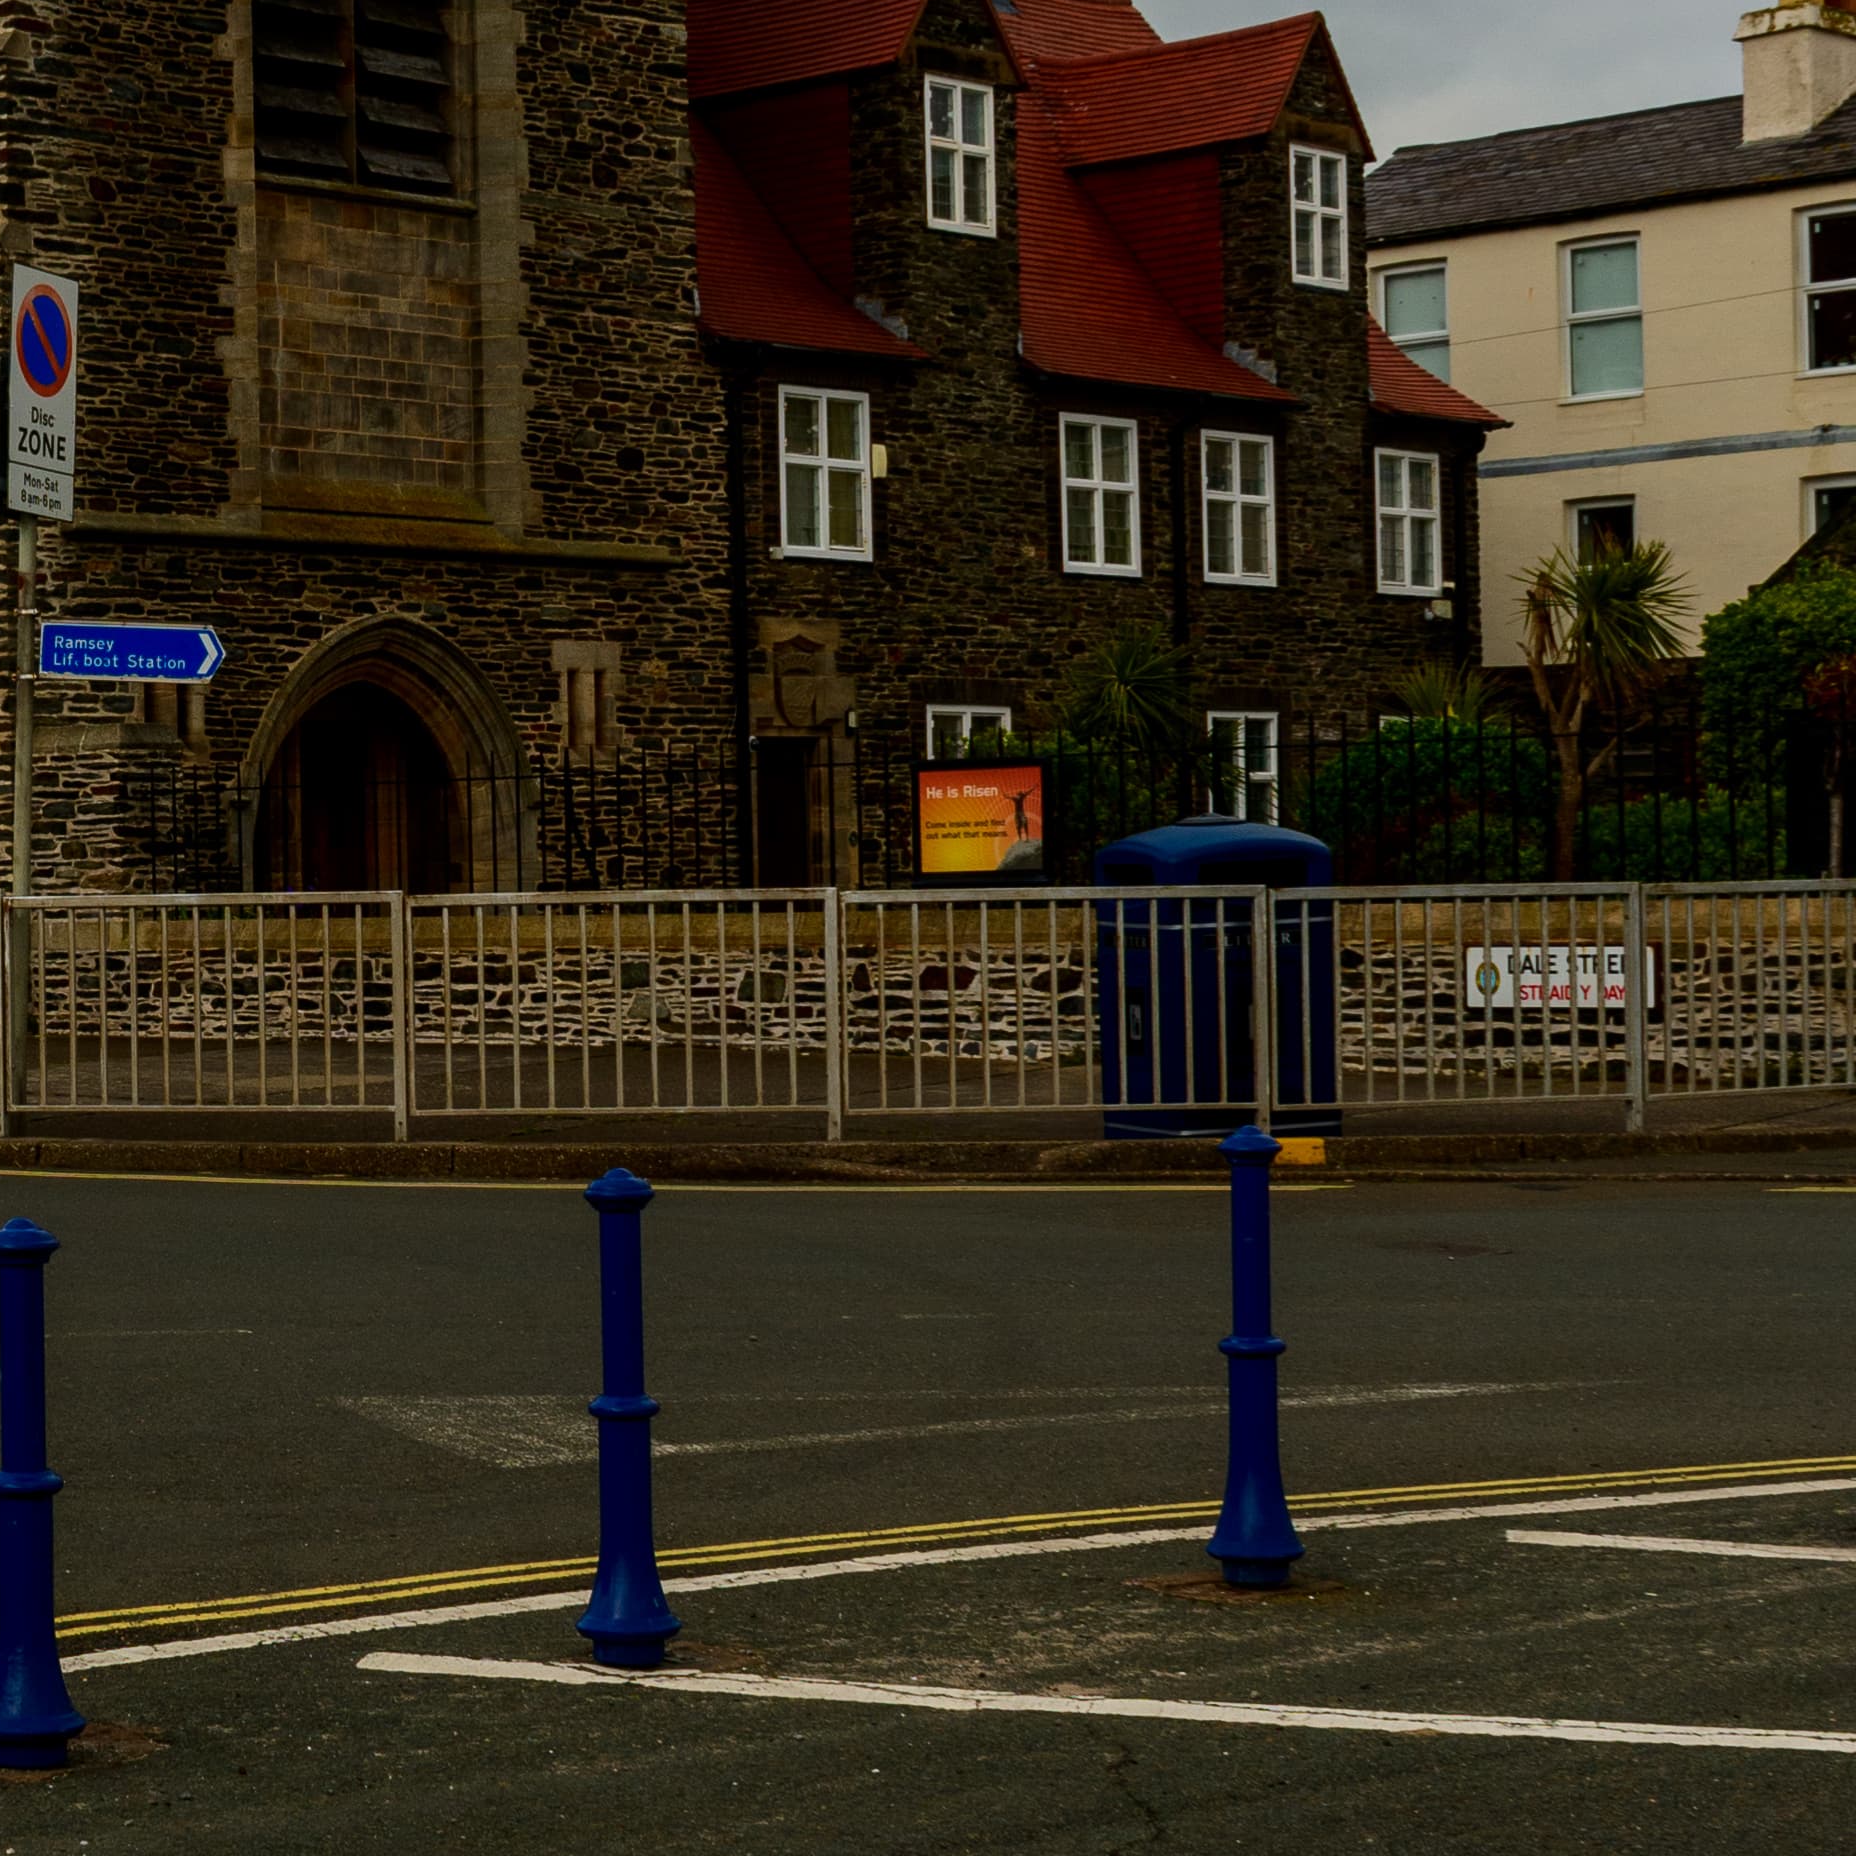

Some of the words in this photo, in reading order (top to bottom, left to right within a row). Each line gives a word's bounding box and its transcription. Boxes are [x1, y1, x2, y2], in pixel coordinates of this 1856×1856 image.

[31, 406, 55, 427] Disc
[18, 427, 66, 461] ZONE
[24, 472, 59, 492] Mon-Sat
[54, 635, 114, 652] Ramsey
[127, 654, 186, 670] Station
[926, 786, 943, 799] He
[963, 784, 999, 798] Risen
[1508, 955, 1558, 974] DALE
